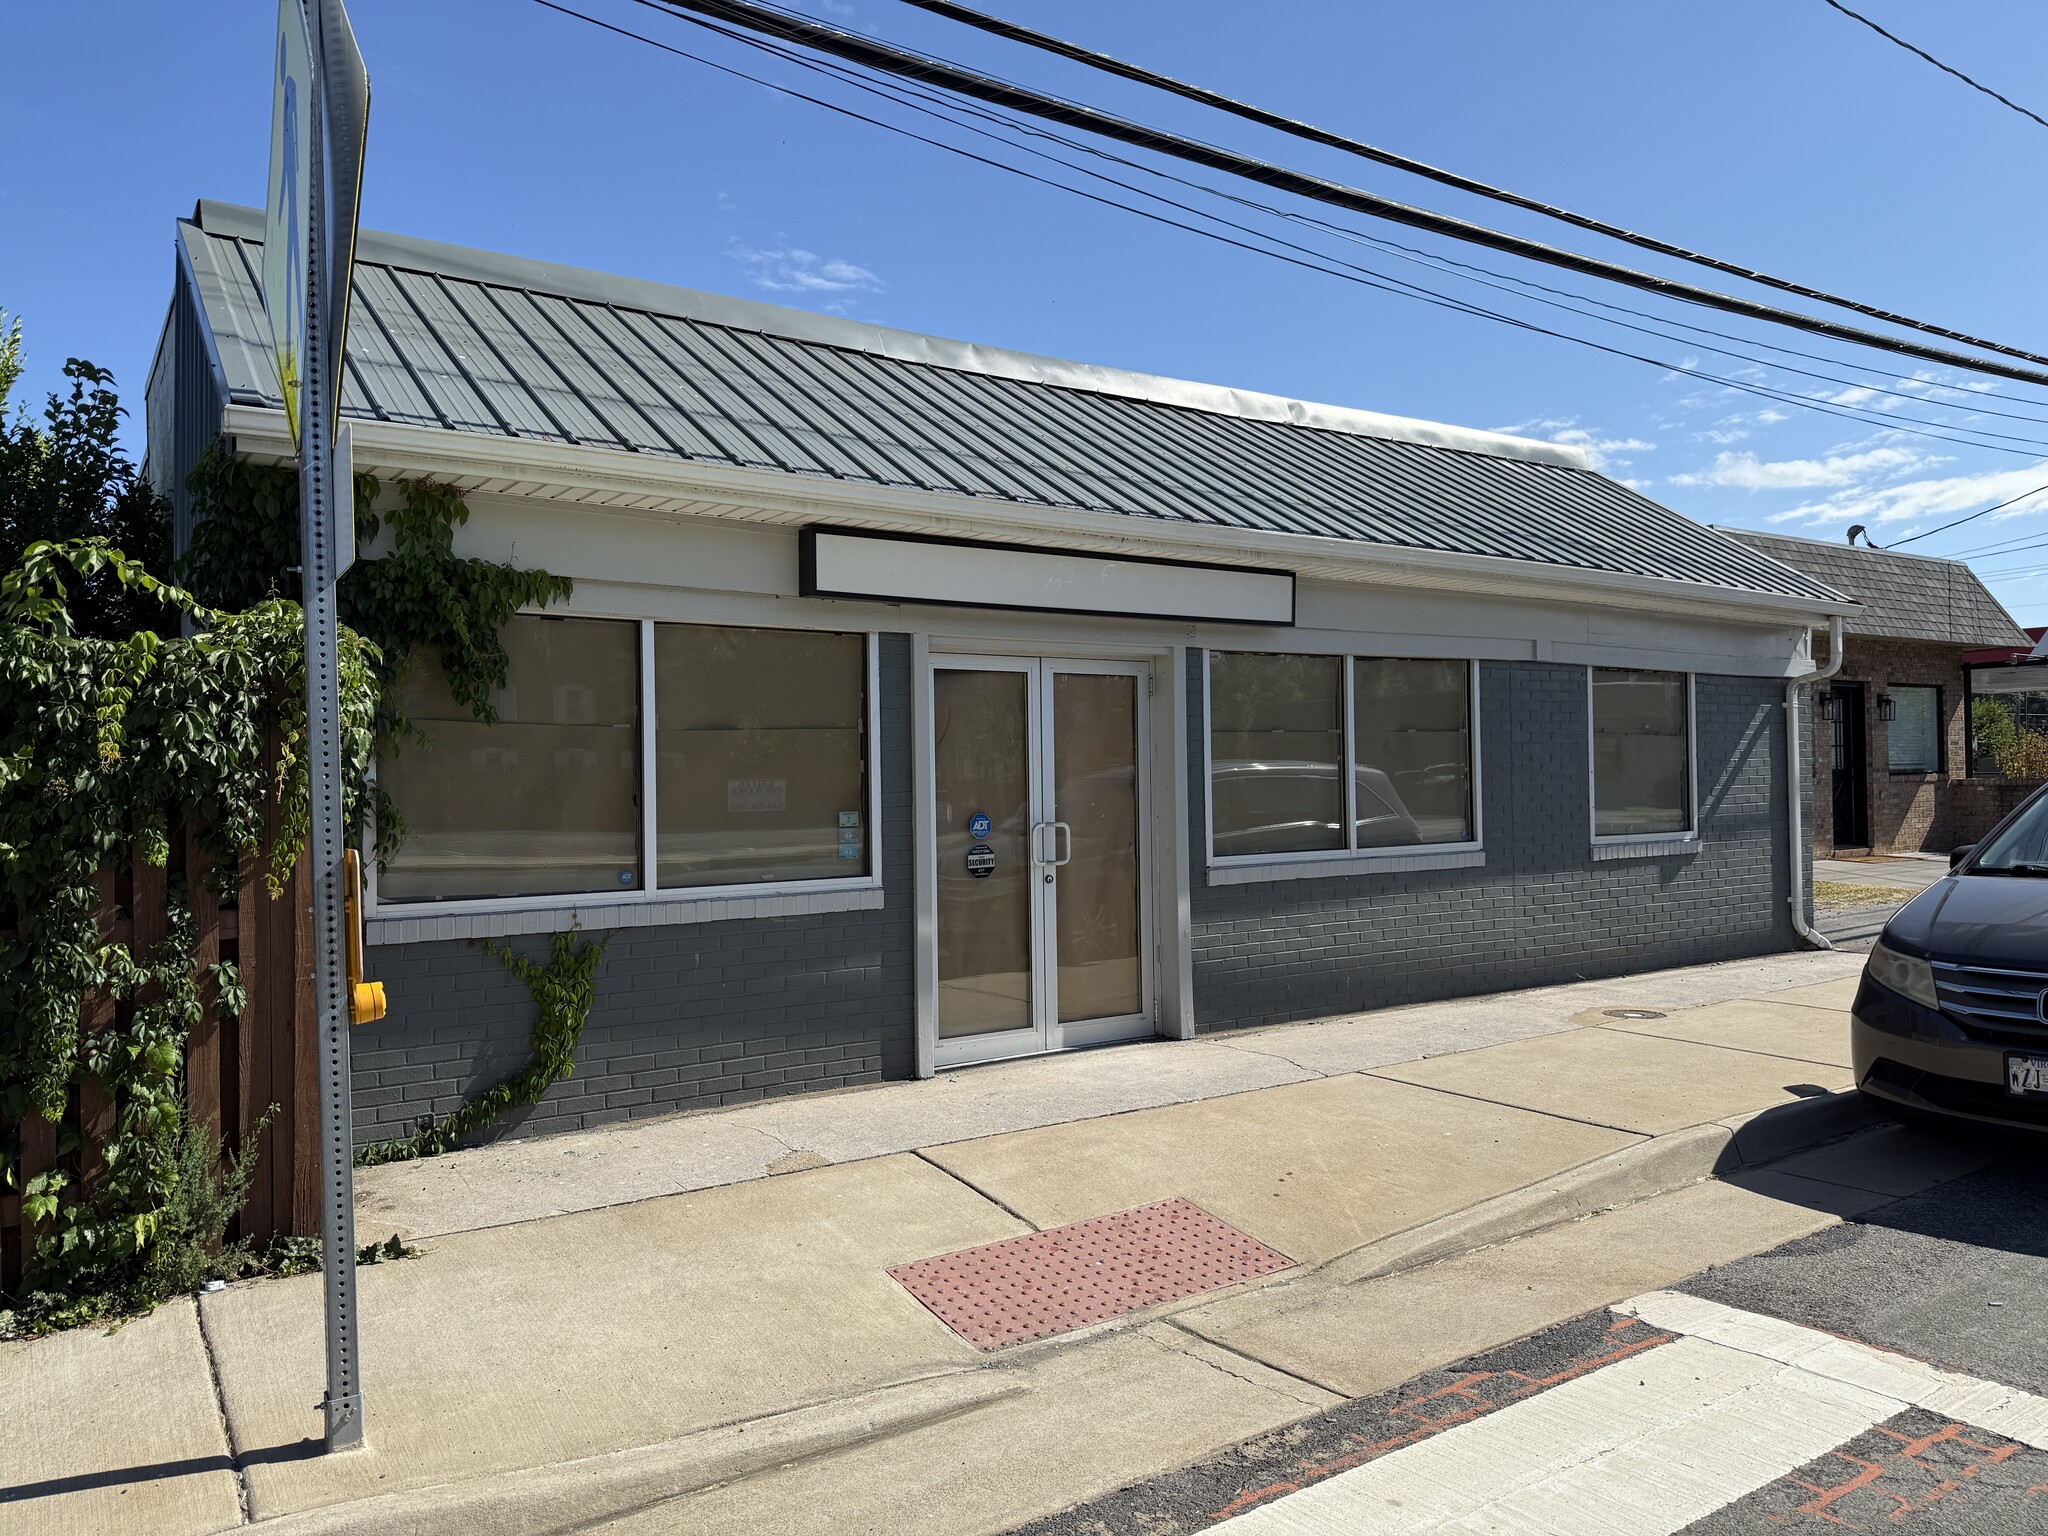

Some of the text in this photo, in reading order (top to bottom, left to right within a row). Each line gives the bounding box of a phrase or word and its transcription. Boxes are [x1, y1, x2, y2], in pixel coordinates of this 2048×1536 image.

[973, 820, 989, 830] ADT
[968, 858, 994, 867] SECURITY
[2031, 1060, 2048, 1068] VIR
